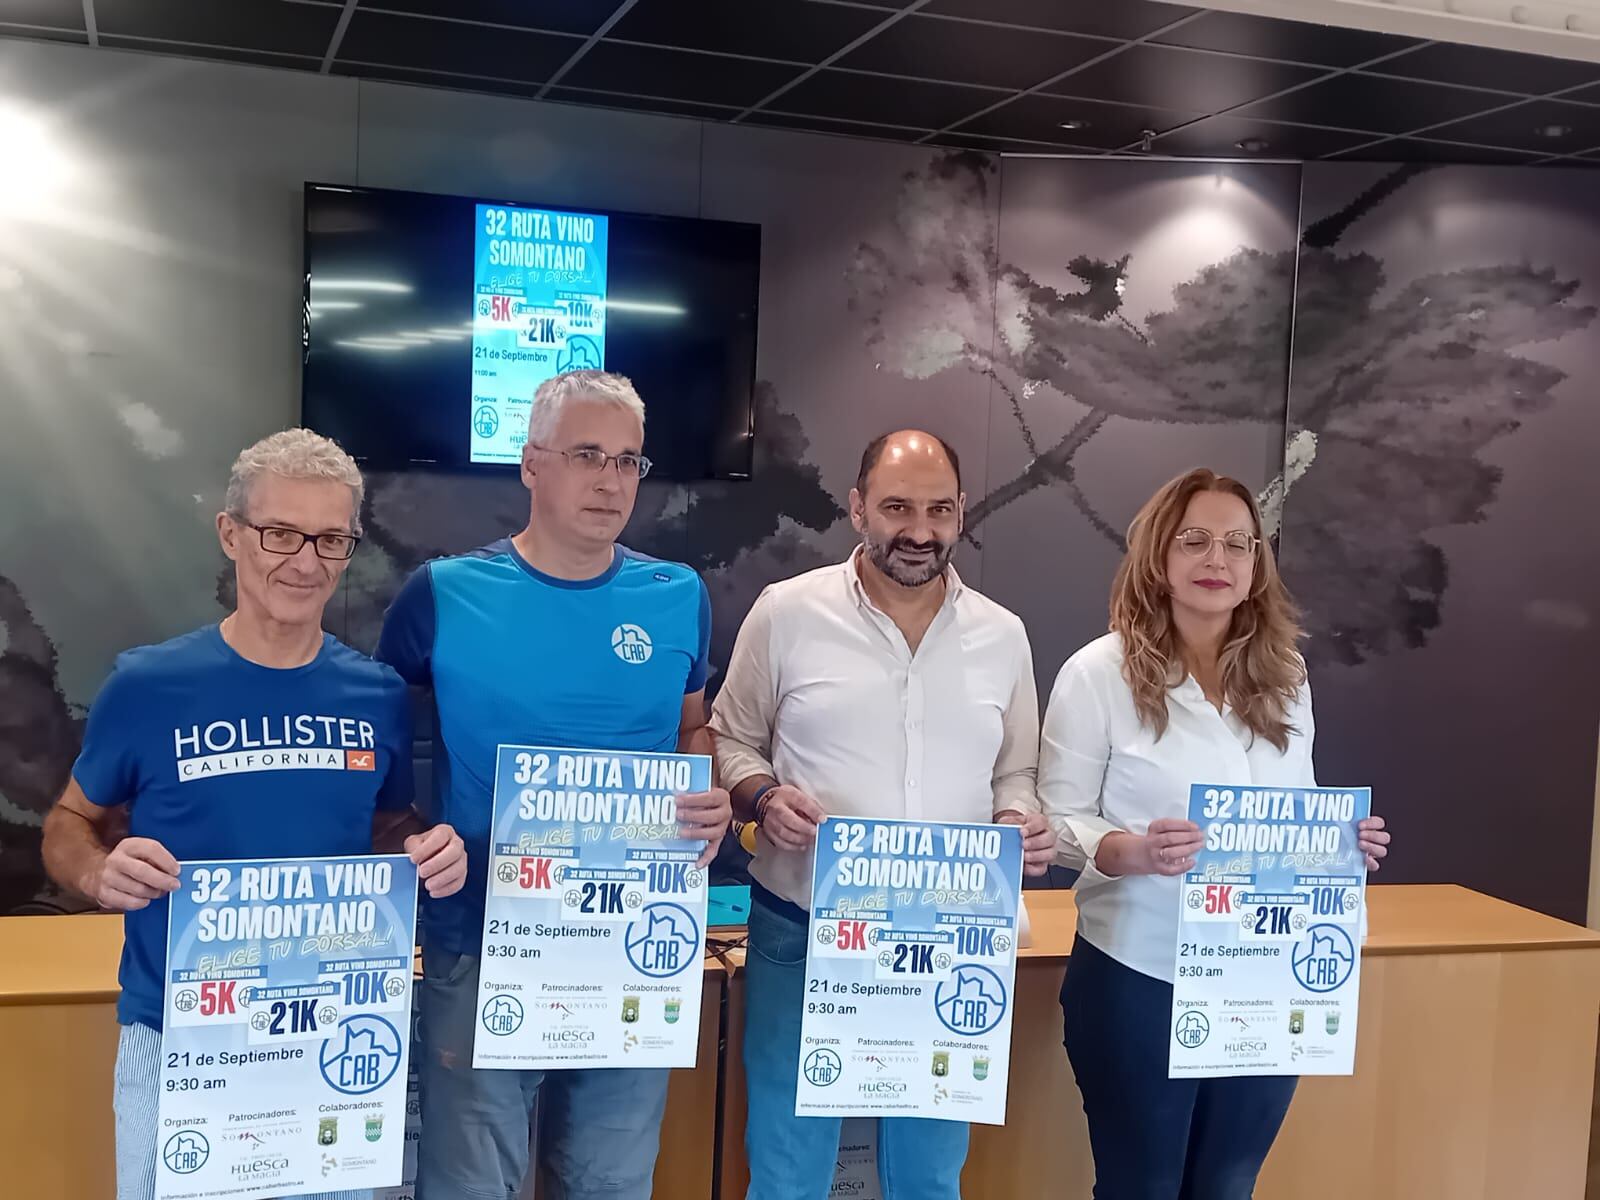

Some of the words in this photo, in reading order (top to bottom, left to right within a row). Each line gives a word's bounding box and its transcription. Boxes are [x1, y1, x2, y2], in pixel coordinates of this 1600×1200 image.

[485, 209, 506, 236] 32
[511, 211, 551, 240] RUTA
[557, 215, 594, 243] VINO
[489, 239, 586, 272] SOMONTANO
[492, 296, 511, 321] 5K
[568, 301, 593, 328] 10K
[529, 317, 555, 343] 21K
[475, 346, 488, 359] 21
[489, 349, 499, 359] de
[502, 349, 548, 362] Septiembre
[622, 644, 646, 661] CAB
[174, 714, 375, 758] HOLLISTER
[183, 753, 337, 776] CALIFORNIA
[514, 753, 550, 785] 32
[557, 755, 623, 789] RUTA
[632, 759, 691, 792] VINO
[519, 789, 677, 825] SOMONTANO
[1203, 789, 1234, 819] 32
[1239, 791, 1295, 820] RUTA
[1303, 793, 1355, 822] VINO
[519, 827, 574, 849] ELIGE
[582, 826, 602, 842] TU
[832, 822, 866, 853] 32
[872, 825, 933, 857] RUTA
[943, 828, 1001, 860] VINO
[1206, 823, 1341, 853] SOMONTANO
[520, 857, 552, 889] 5K
[647, 862, 689, 893] 10K
[836, 857, 986, 892] SOMONTANO
[1205, 857, 1251, 877] ELIGE
[1259, 856, 1276, 870] TU
[1282, 851, 1353, 868] DORSAL!
[191, 868, 231, 904] 32
[240, 865, 314, 902] RUTA
[325, 862, 392, 897] VINO
[580, 882, 625, 914] 21K
[838, 894, 887, 913] ELIGE
[895, 891, 913, 907] TU
[921, 887, 1001, 905] DORSAL!
[1205, 885, 1232, 914] 5K
[1311, 887, 1347, 915] 10K
[197, 900, 376, 943] SOMONTANO
[488, 920, 510, 935] 21
[514, 924, 531, 936] de
[534, 923, 611, 939] Septiembre
[1255, 906, 1293, 935] 21K
[837, 920, 867, 950] 5K
[956, 926, 995, 956] 10K
[198, 947, 261, 974] ELIGE
[270, 940, 291, 961] TU
[302, 925, 394, 955] DORSAL!
[487, 945, 516, 958] 9:30
[520, 948, 541, 959] am
[642, 940, 679, 970] CAB
[893, 943, 935, 974] 21K
[1180, 943, 1198, 957] 21
[1201, 946, 1214, 957] de
[1217, 945, 1280, 959] Septiembre
[1179, 966, 1203, 977] 9:30
[1205, 968, 1223, 977] am
[1306, 958, 1338, 985] CAB
[200, 981, 237, 1016] 5K
[342, 971, 387, 1006] 10K
[541, 983, 603, 992] Patrocinadores:
[623, 984, 681, 992] Colaboradores:
[809, 979, 829, 993] 21
[832, 982, 848, 994] de
[851, 982, 922, 997] Septiembre
[269, 999, 319, 1036] 21K
[808, 1002, 835, 1014] 9:30
[838, 1005, 857, 1015] am
[951, 999, 988, 1029] CAB
[491, 1014, 513, 1032] CAB
[1183, 1029, 1201, 1044] CAB
[857, 1037, 915, 1047] Patrocinadores:
[932, 1039, 989, 1051] Colaboradores:
[167, 1052, 190, 1068] 21
[196, 1052, 214, 1066] de
[219, 1047, 304, 1067] Septiembre
[339, 1053, 380, 1087] CAB
[166, 1078, 199, 1092] 9:30
[203, 1078, 226, 1090] am
[812, 1067, 832, 1082] CAB
[228, 1109, 296, 1122] Patrocinadores:
[318, 1101, 384, 1112] Colaboradores:
[174, 1151, 197, 1170] CAB
